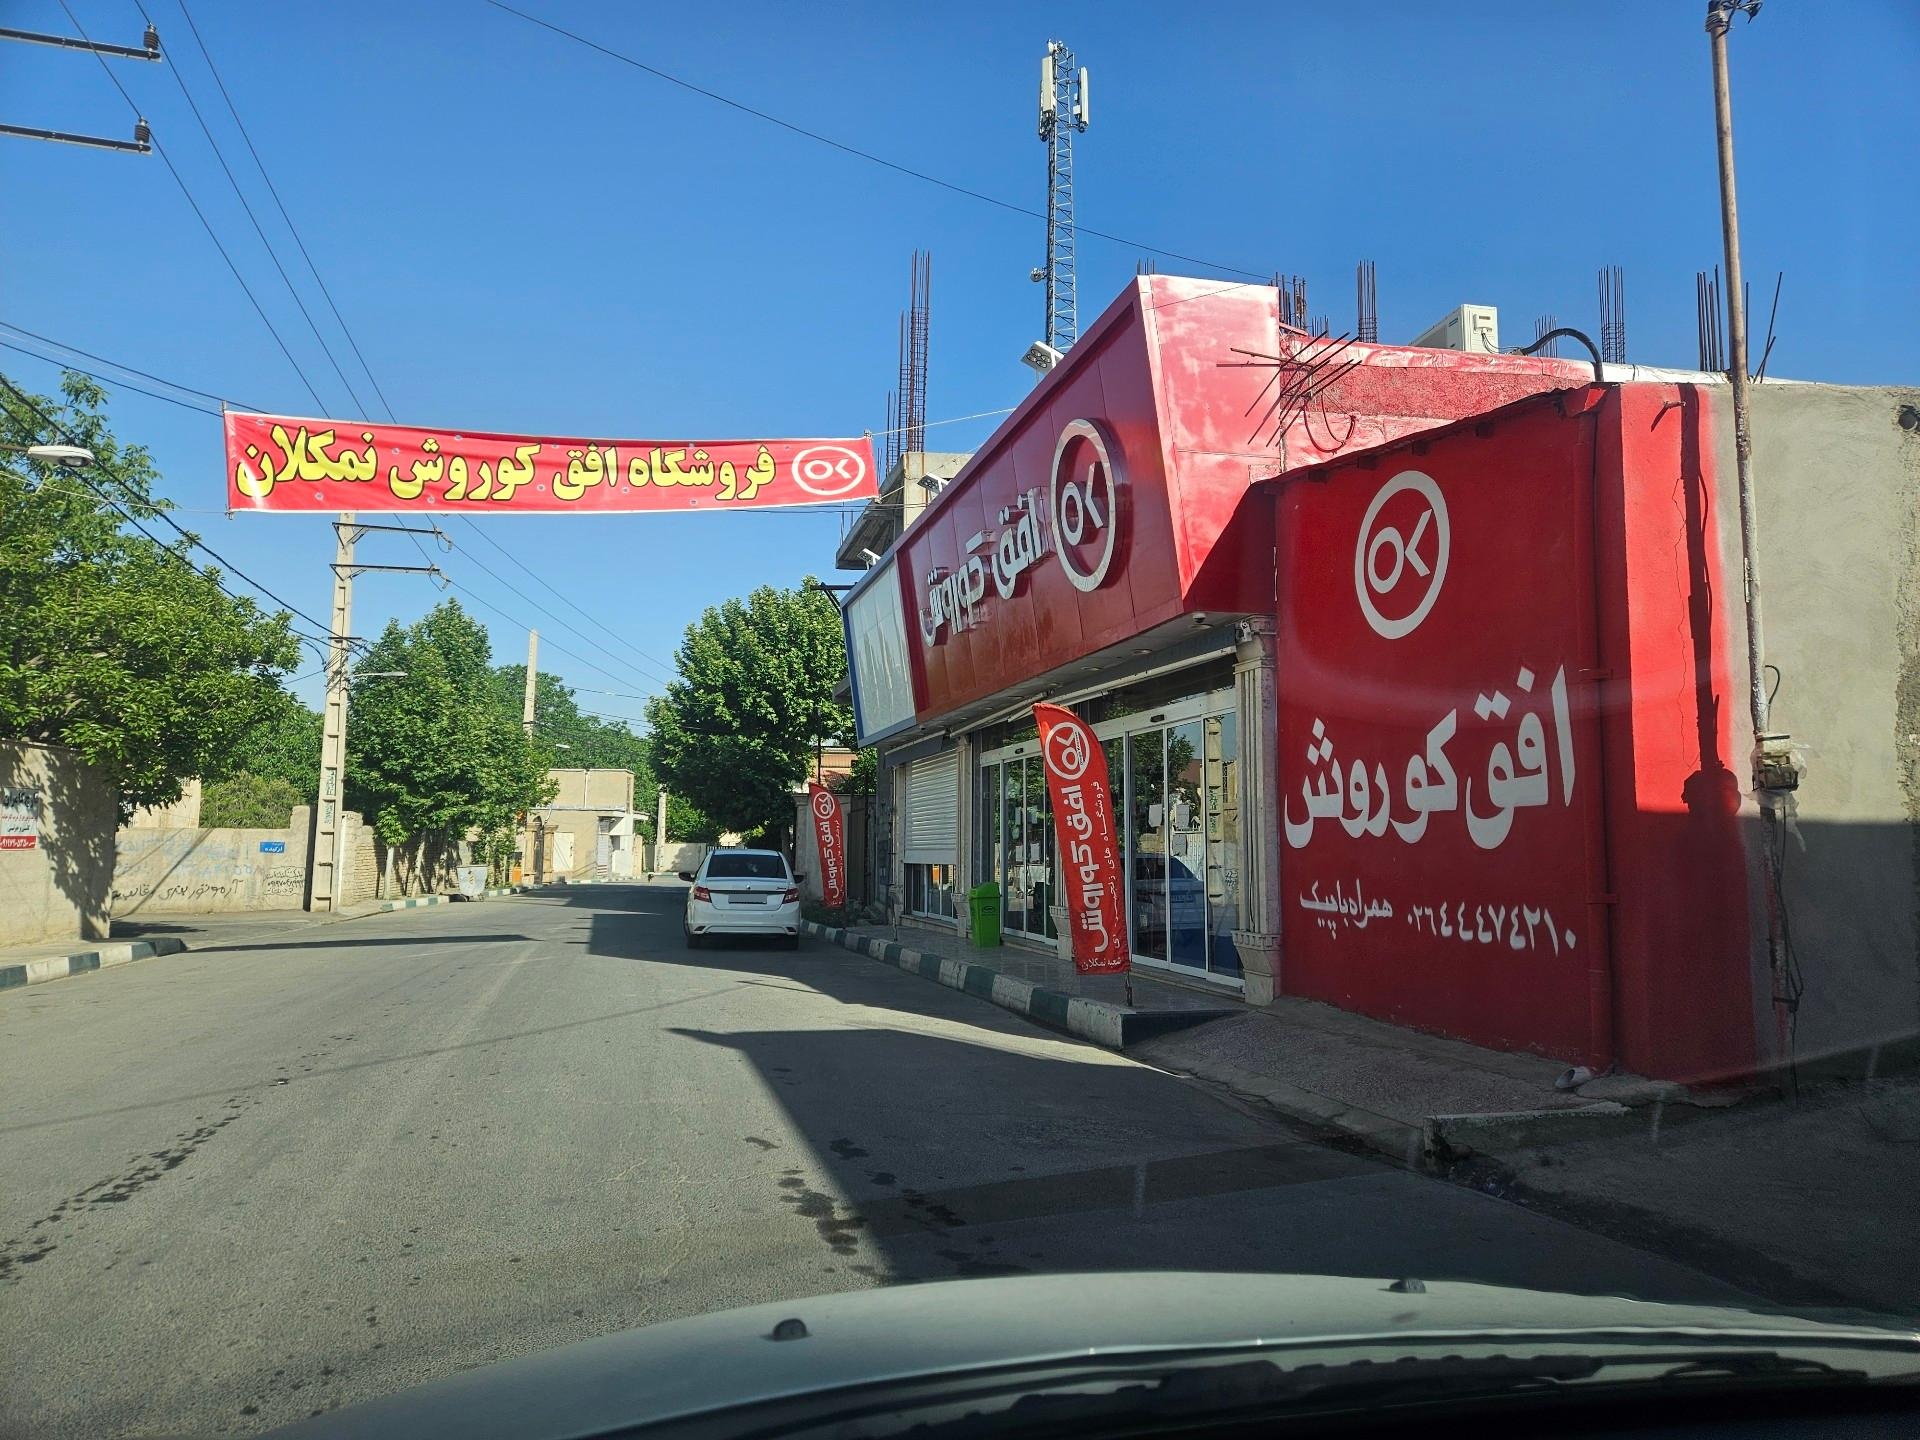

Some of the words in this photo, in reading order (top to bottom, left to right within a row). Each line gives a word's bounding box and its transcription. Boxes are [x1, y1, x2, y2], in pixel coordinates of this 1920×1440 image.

[235, 423, 378, 499] نمکلان
[389, 437, 542, 500] کوروش
[552, 442, 618, 500] افق
[627, 445, 776, 500] فروشگاه
[992, 487, 1044, 600] افق
[919, 531, 985, 648] کوروش
[1284, 707, 1458, 849] کوروش
[1465, 664, 1576, 850] افق
[1061, 785, 1093, 841] افق
[1090, 781, 1109, 842] فروشگاه
[1071, 841, 1109, 953] کوروش
[1349, 878, 1393, 928] همراه
